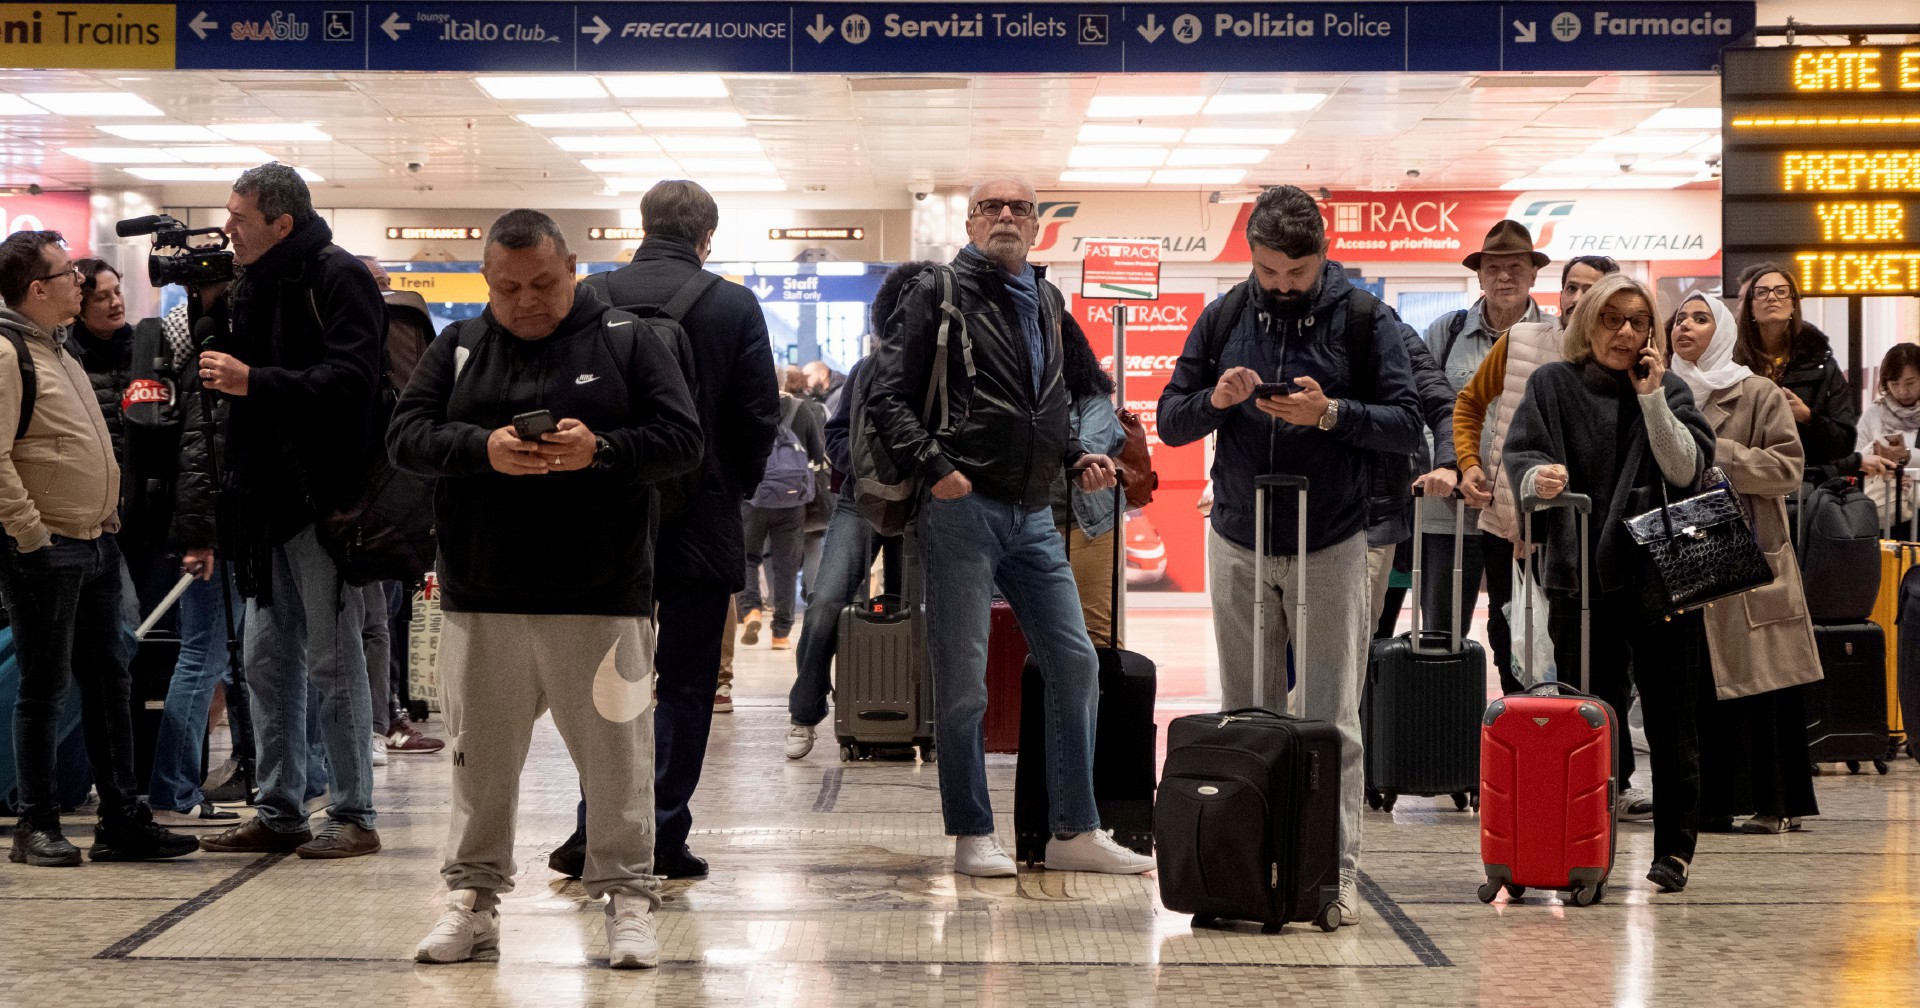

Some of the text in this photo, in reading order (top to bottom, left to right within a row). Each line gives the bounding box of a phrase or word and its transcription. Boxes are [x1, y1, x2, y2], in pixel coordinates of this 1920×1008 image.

[416, 12, 450, 23] lounge
[884, 12, 1067, 38] Servizi Toilets
[1214, 12, 1391, 37] Polizia Police
[1594, 11, 1732, 35] Farmacia
[0, 10, 160, 45] ni Trains
[503, 24, 546, 41] Club
[1795, 52, 1881, 89] GATE
[1817, 203, 1903, 240] YOUR
[401, 228, 467, 239] ENTRANCE
[1335, 237, 1461, 252] Accesso prioritario
[1569, 234, 1704, 250] TRENITALIA
[399, 276, 435, 288] Treni
[782, 276, 819, 290] Staff
[782, 290, 822, 302] Staff only
[130, 387, 170, 401] STOP
[873, 604, 884, 613] E
